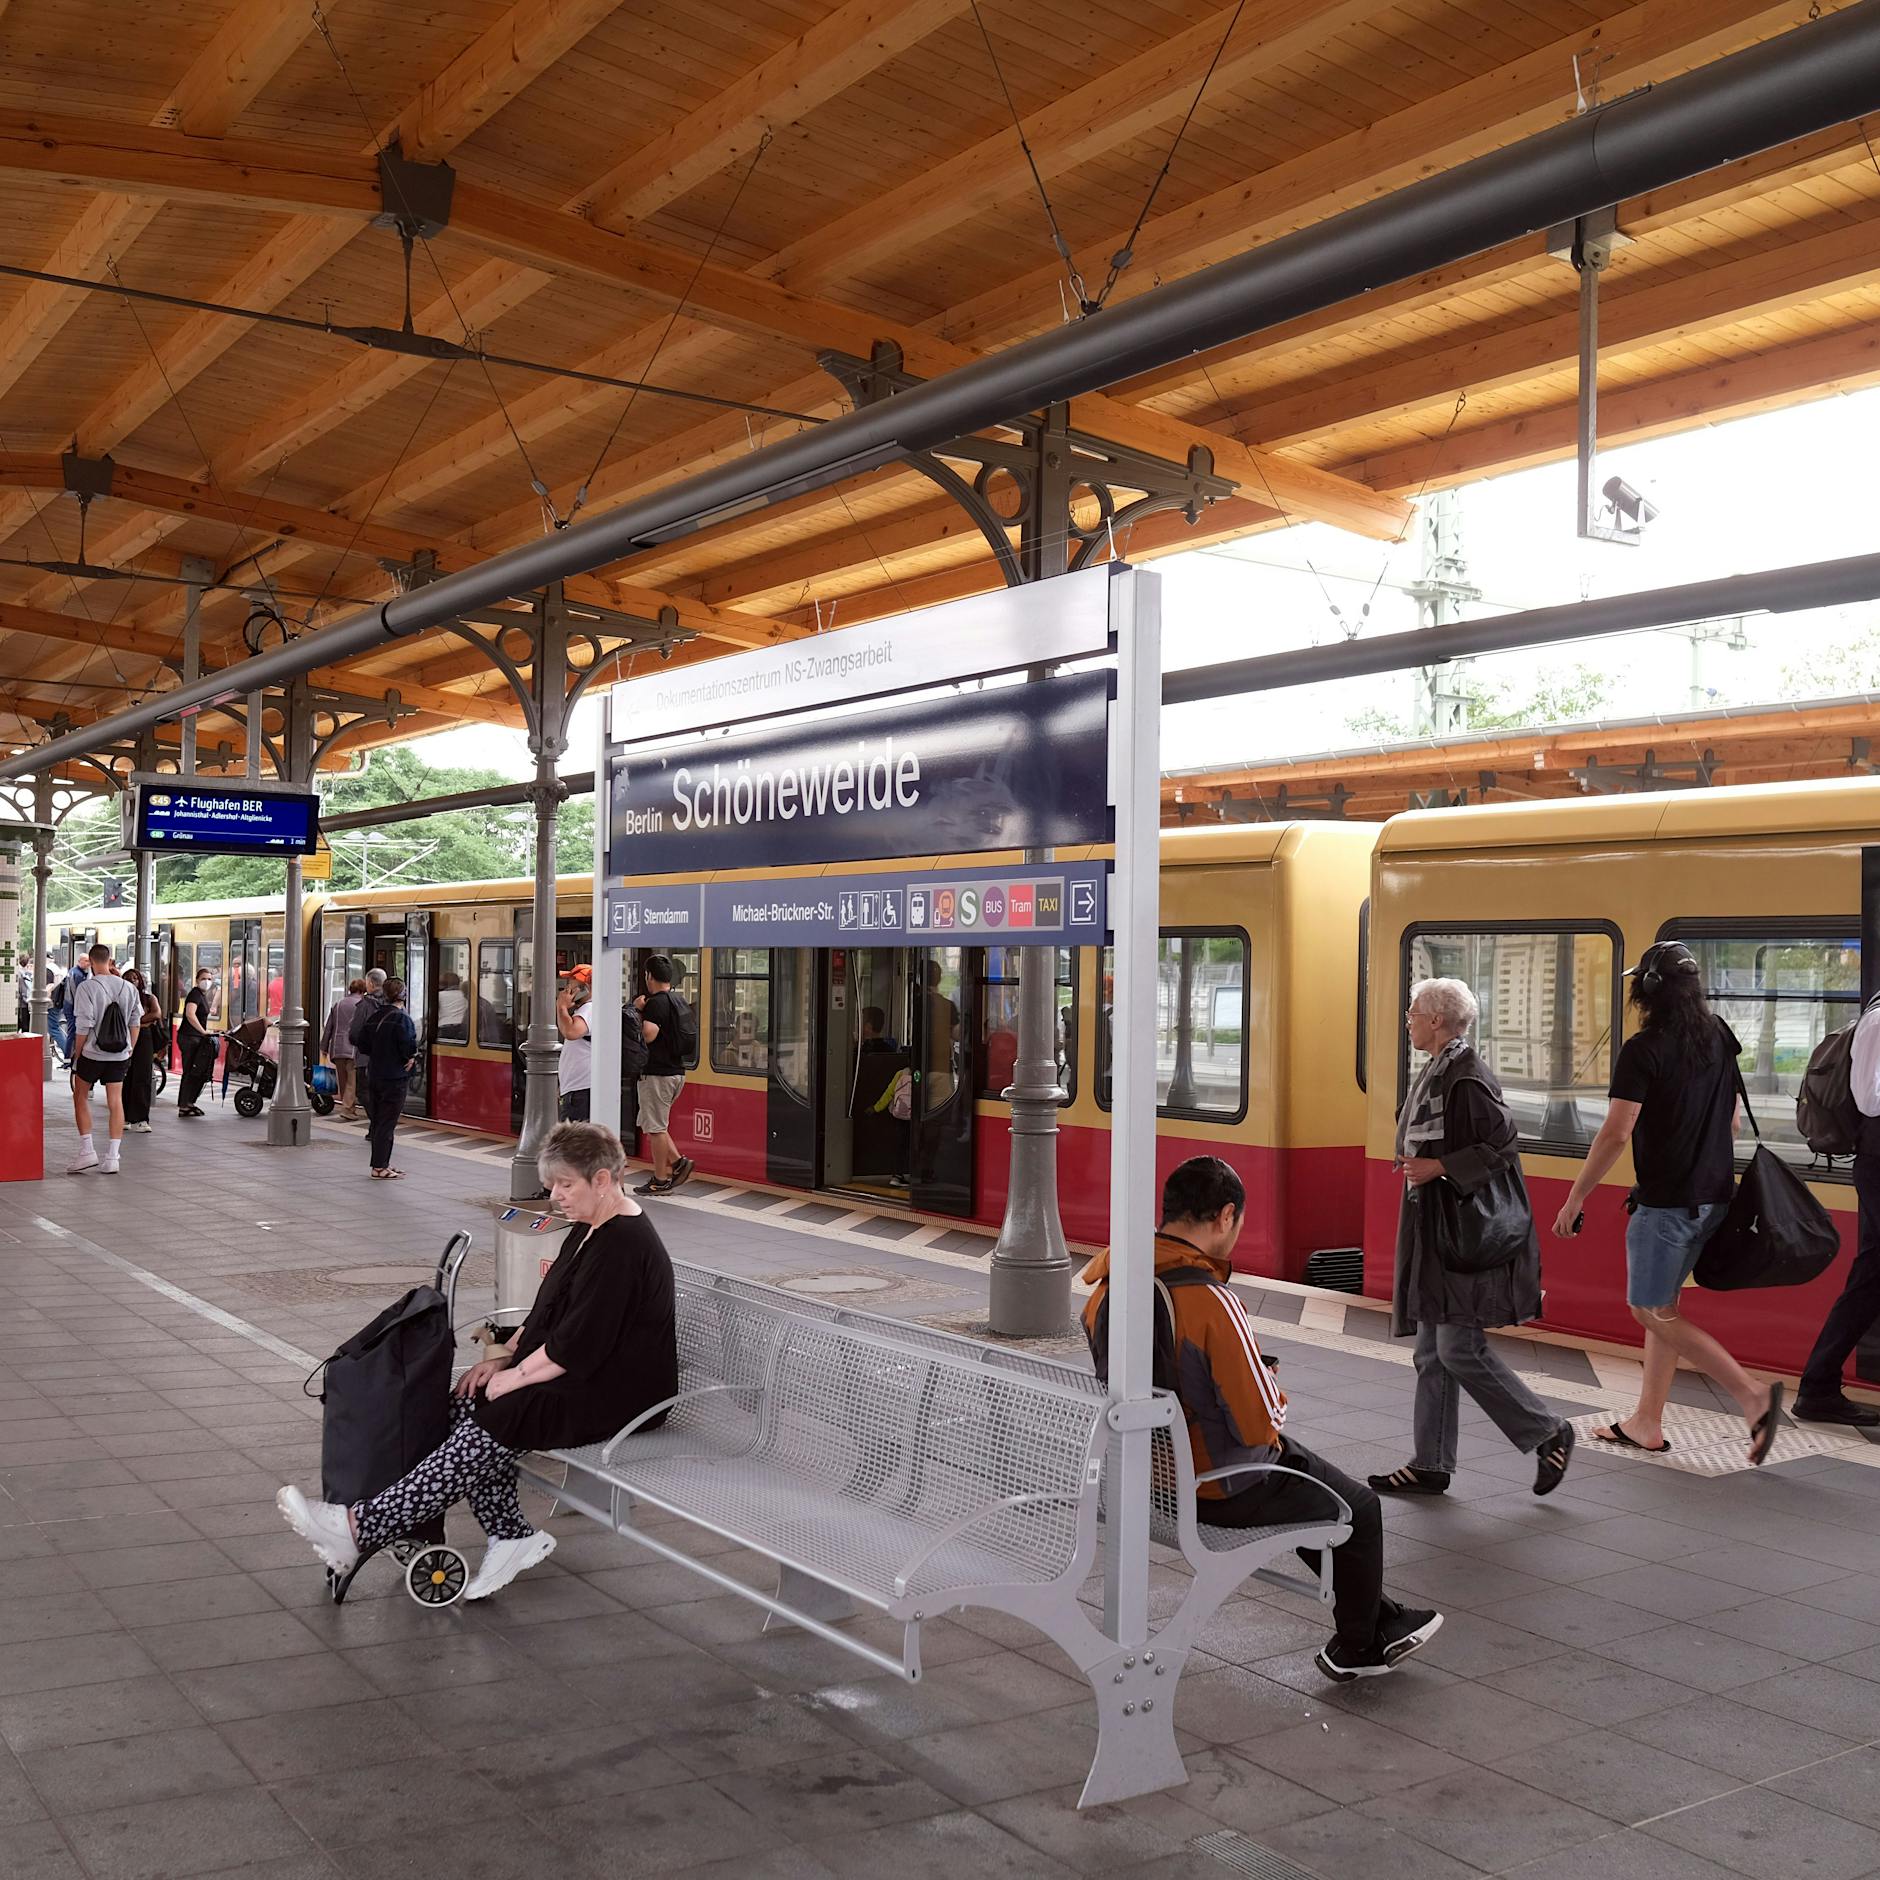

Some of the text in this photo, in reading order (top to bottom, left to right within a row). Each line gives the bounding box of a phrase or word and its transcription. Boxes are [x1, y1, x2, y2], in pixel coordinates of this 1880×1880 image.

[656, 640, 893, 708] Dokumentationszentrum NS-Zwangsarbeit
[625, 737, 921, 836] Berlin Schöneweide
[150, 796, 263, 813] S45 Flughafen BER
[732, 902, 835, 923] Michael-Brückner-Str.
[960, 890, 977, 926] S
[985, 900, 1003, 914] BUS
[1010, 899, 1032, 913] Tram
[1038, 897, 1058, 912] TAXI
[643, 907, 689, 925] Sterndamm
[695, 1113, 712, 1137] DB
